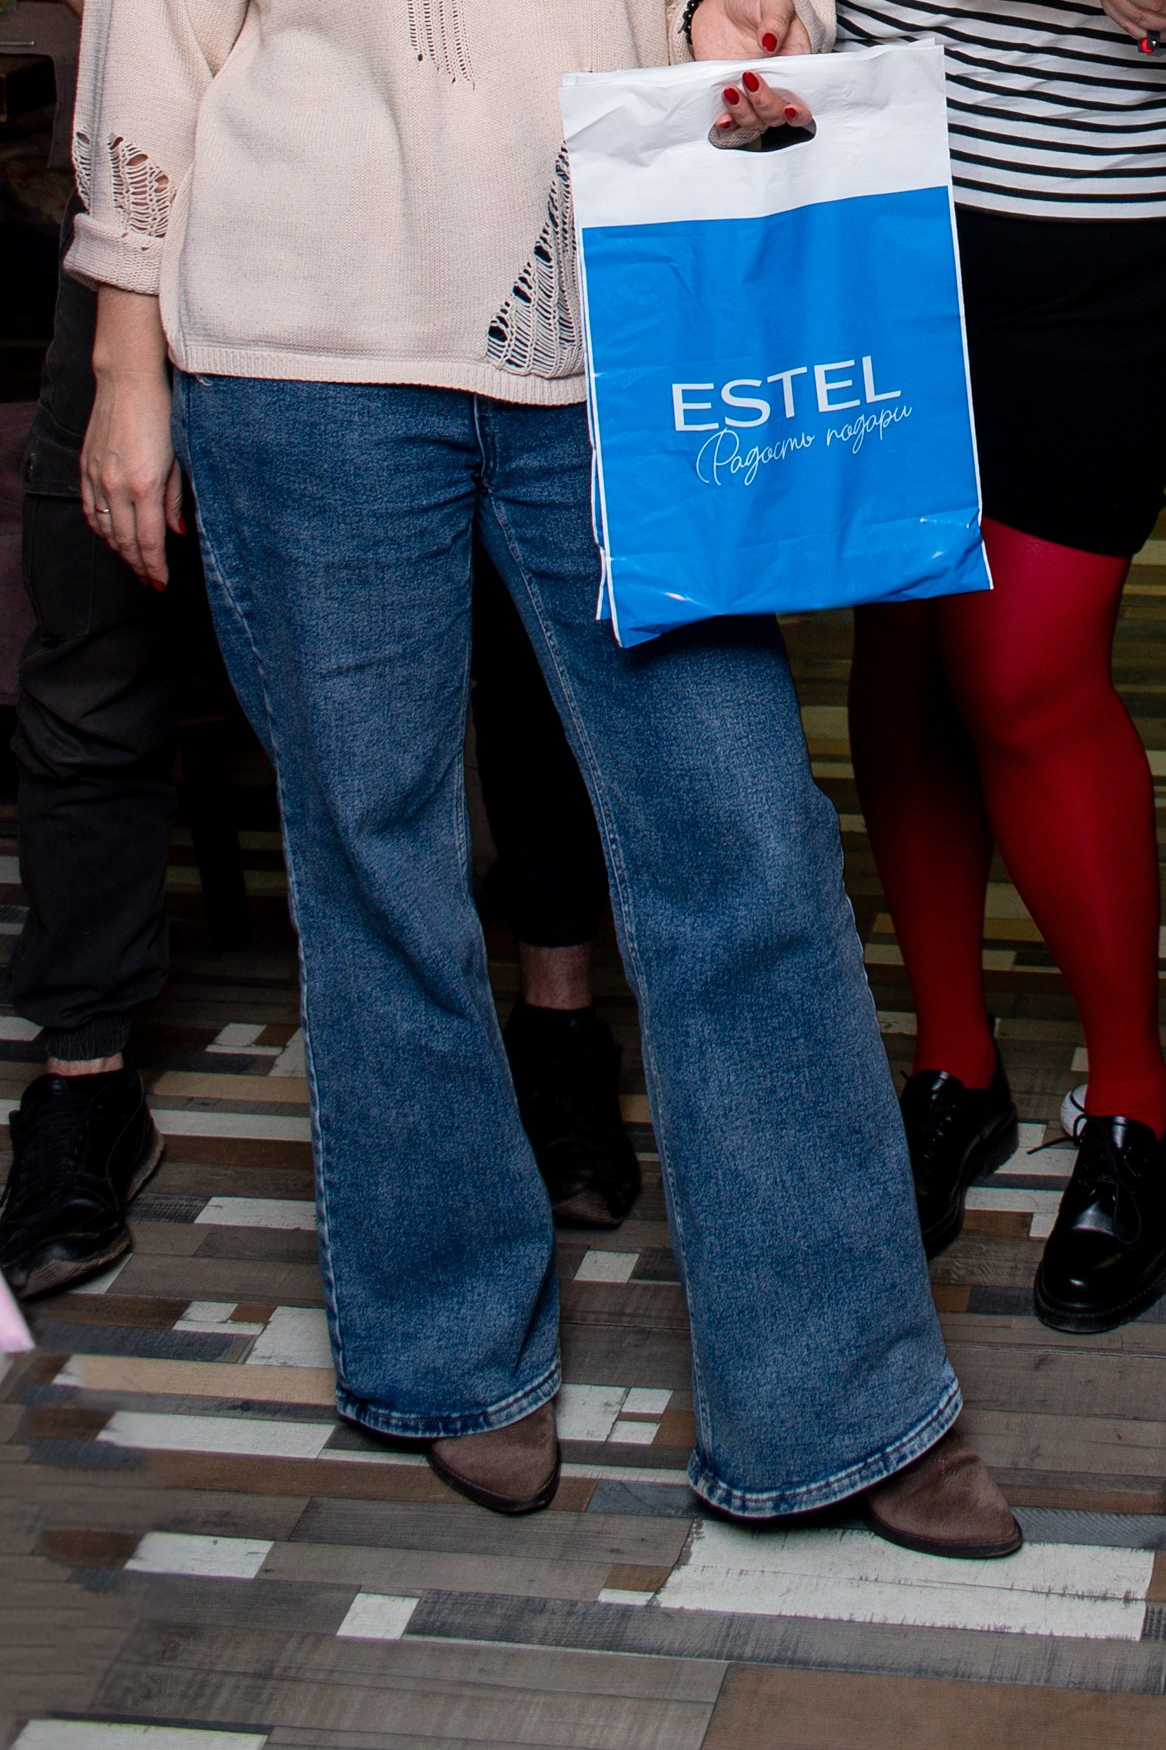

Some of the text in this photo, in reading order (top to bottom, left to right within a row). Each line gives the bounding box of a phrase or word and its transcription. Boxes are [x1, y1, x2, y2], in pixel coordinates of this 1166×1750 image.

[671, 355, 902, 432] ESTEL
[696, 404, 913, 486] Радость подари
